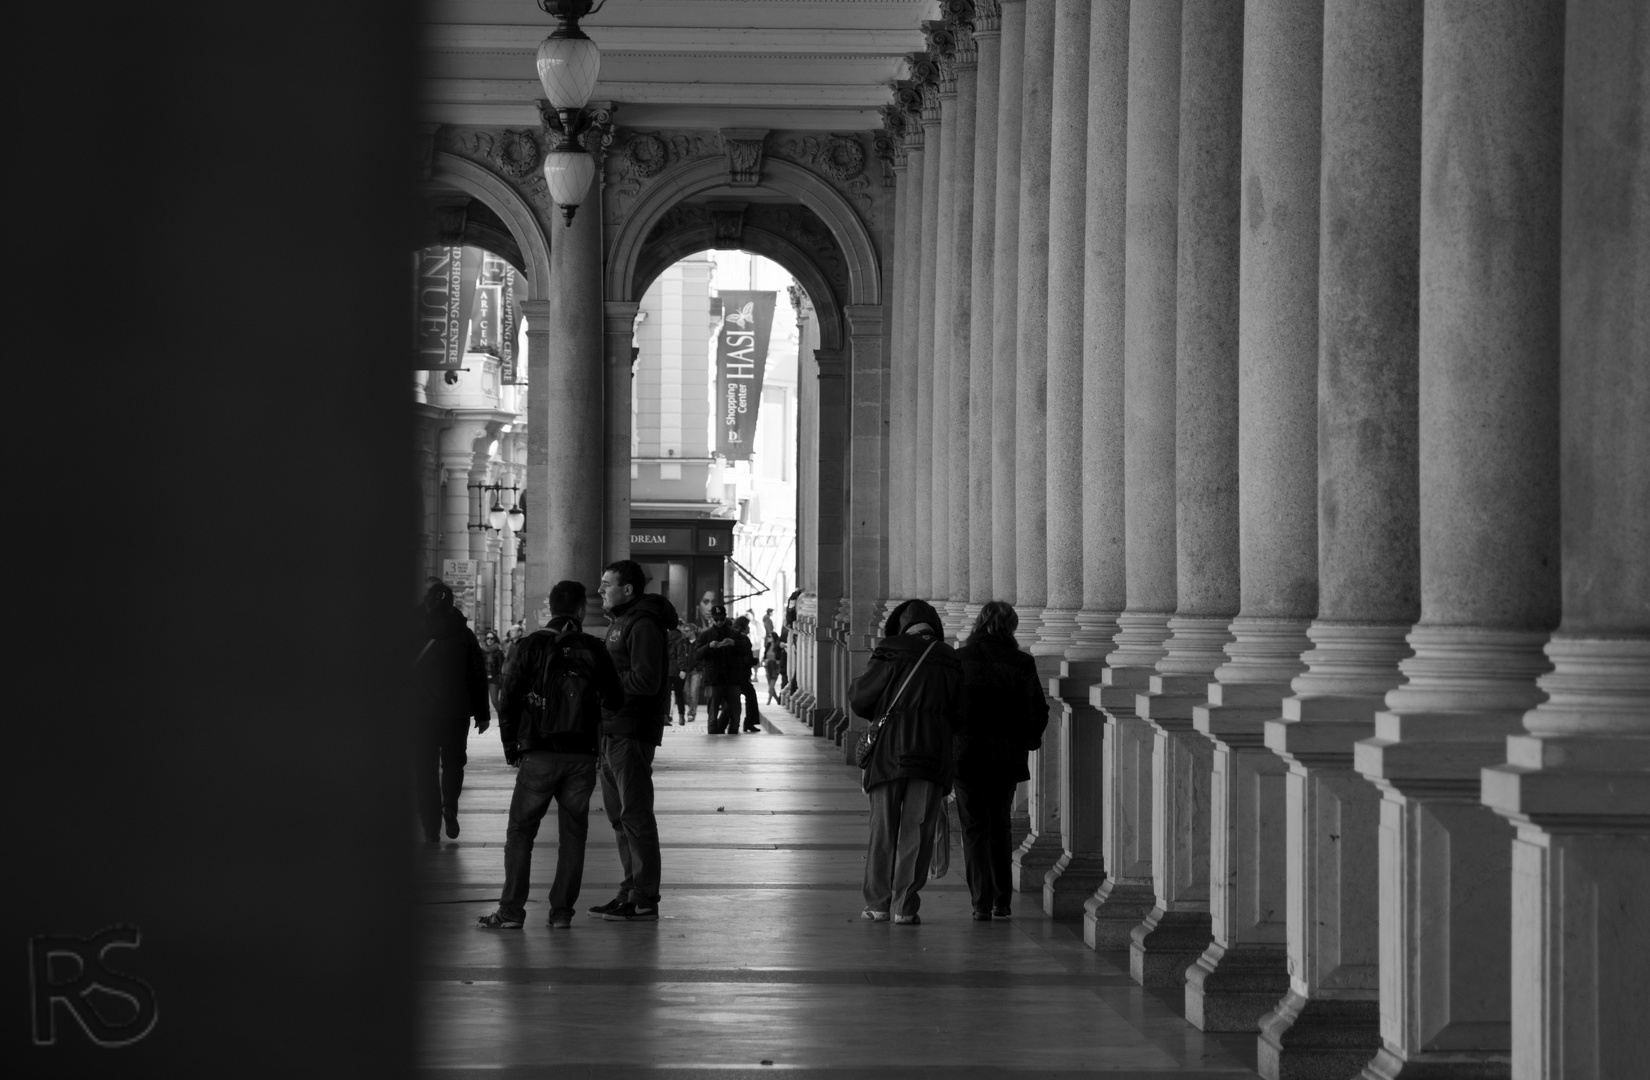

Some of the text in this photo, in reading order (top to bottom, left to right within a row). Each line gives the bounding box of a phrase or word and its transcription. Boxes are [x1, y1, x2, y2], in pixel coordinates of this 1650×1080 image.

[450, 260, 460, 318] SHOPPING
[480, 291, 488, 317] ART
[504, 288, 513, 340] SHOPPING
[449, 321, 459, 364] CENTRE
[503, 341, 512, 381] CENTRE
[726, 331, 754, 379] HASI
[726, 383, 738, 425] Shopping
[737, 384, 747, 413] Center
[630, 534, 666, 544] DREAM
[708, 536, 716, 547] D
